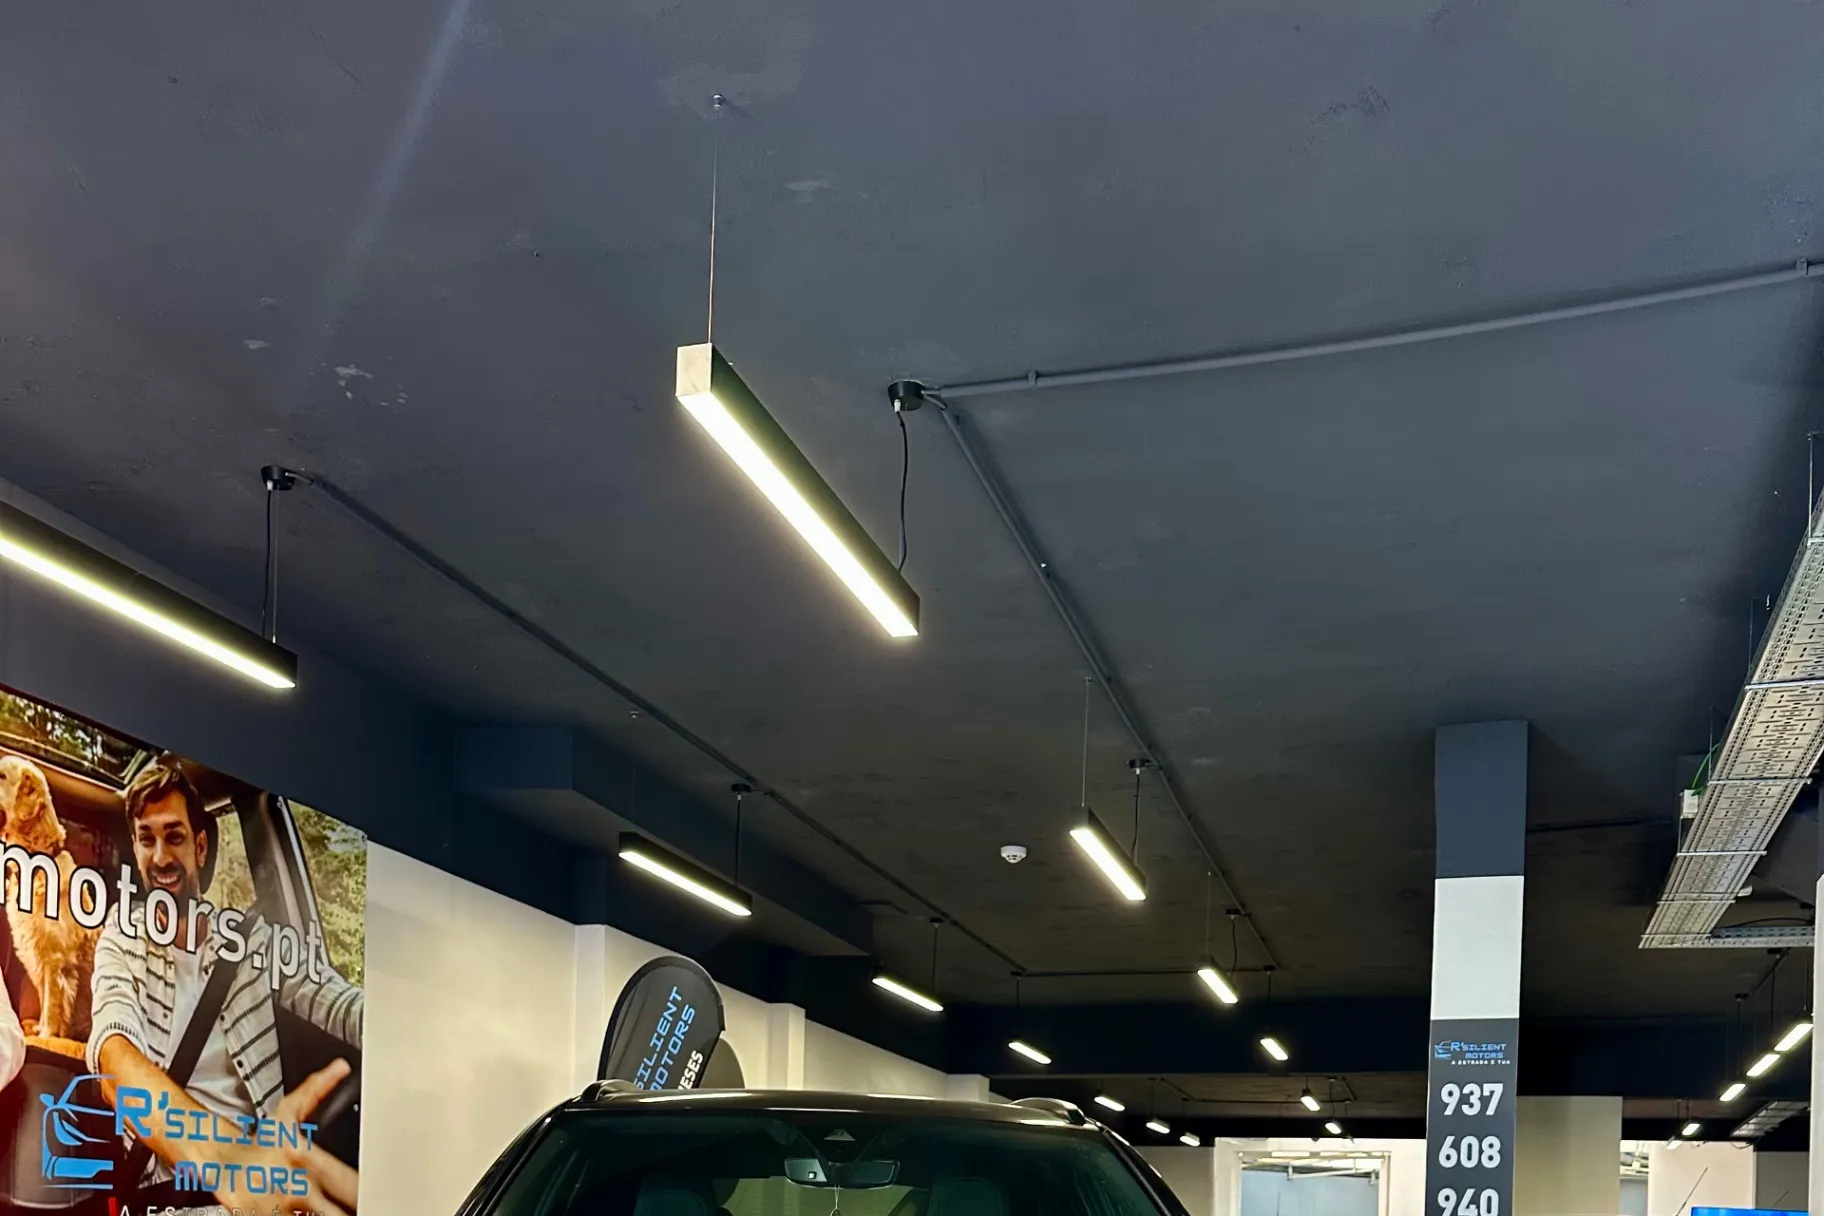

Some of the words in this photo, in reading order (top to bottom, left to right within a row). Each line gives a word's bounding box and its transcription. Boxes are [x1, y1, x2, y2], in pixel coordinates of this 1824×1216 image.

[0, 841, 323, 990] motors.pt
[678, 1050, 703, 1090] ESES
[115, 1086, 318, 1151] R'SILIENT
[1441, 1083, 1503, 1116] 937
[1438, 1136, 1501, 1168] 608
[175, 1160, 309, 1197] MOTORS
